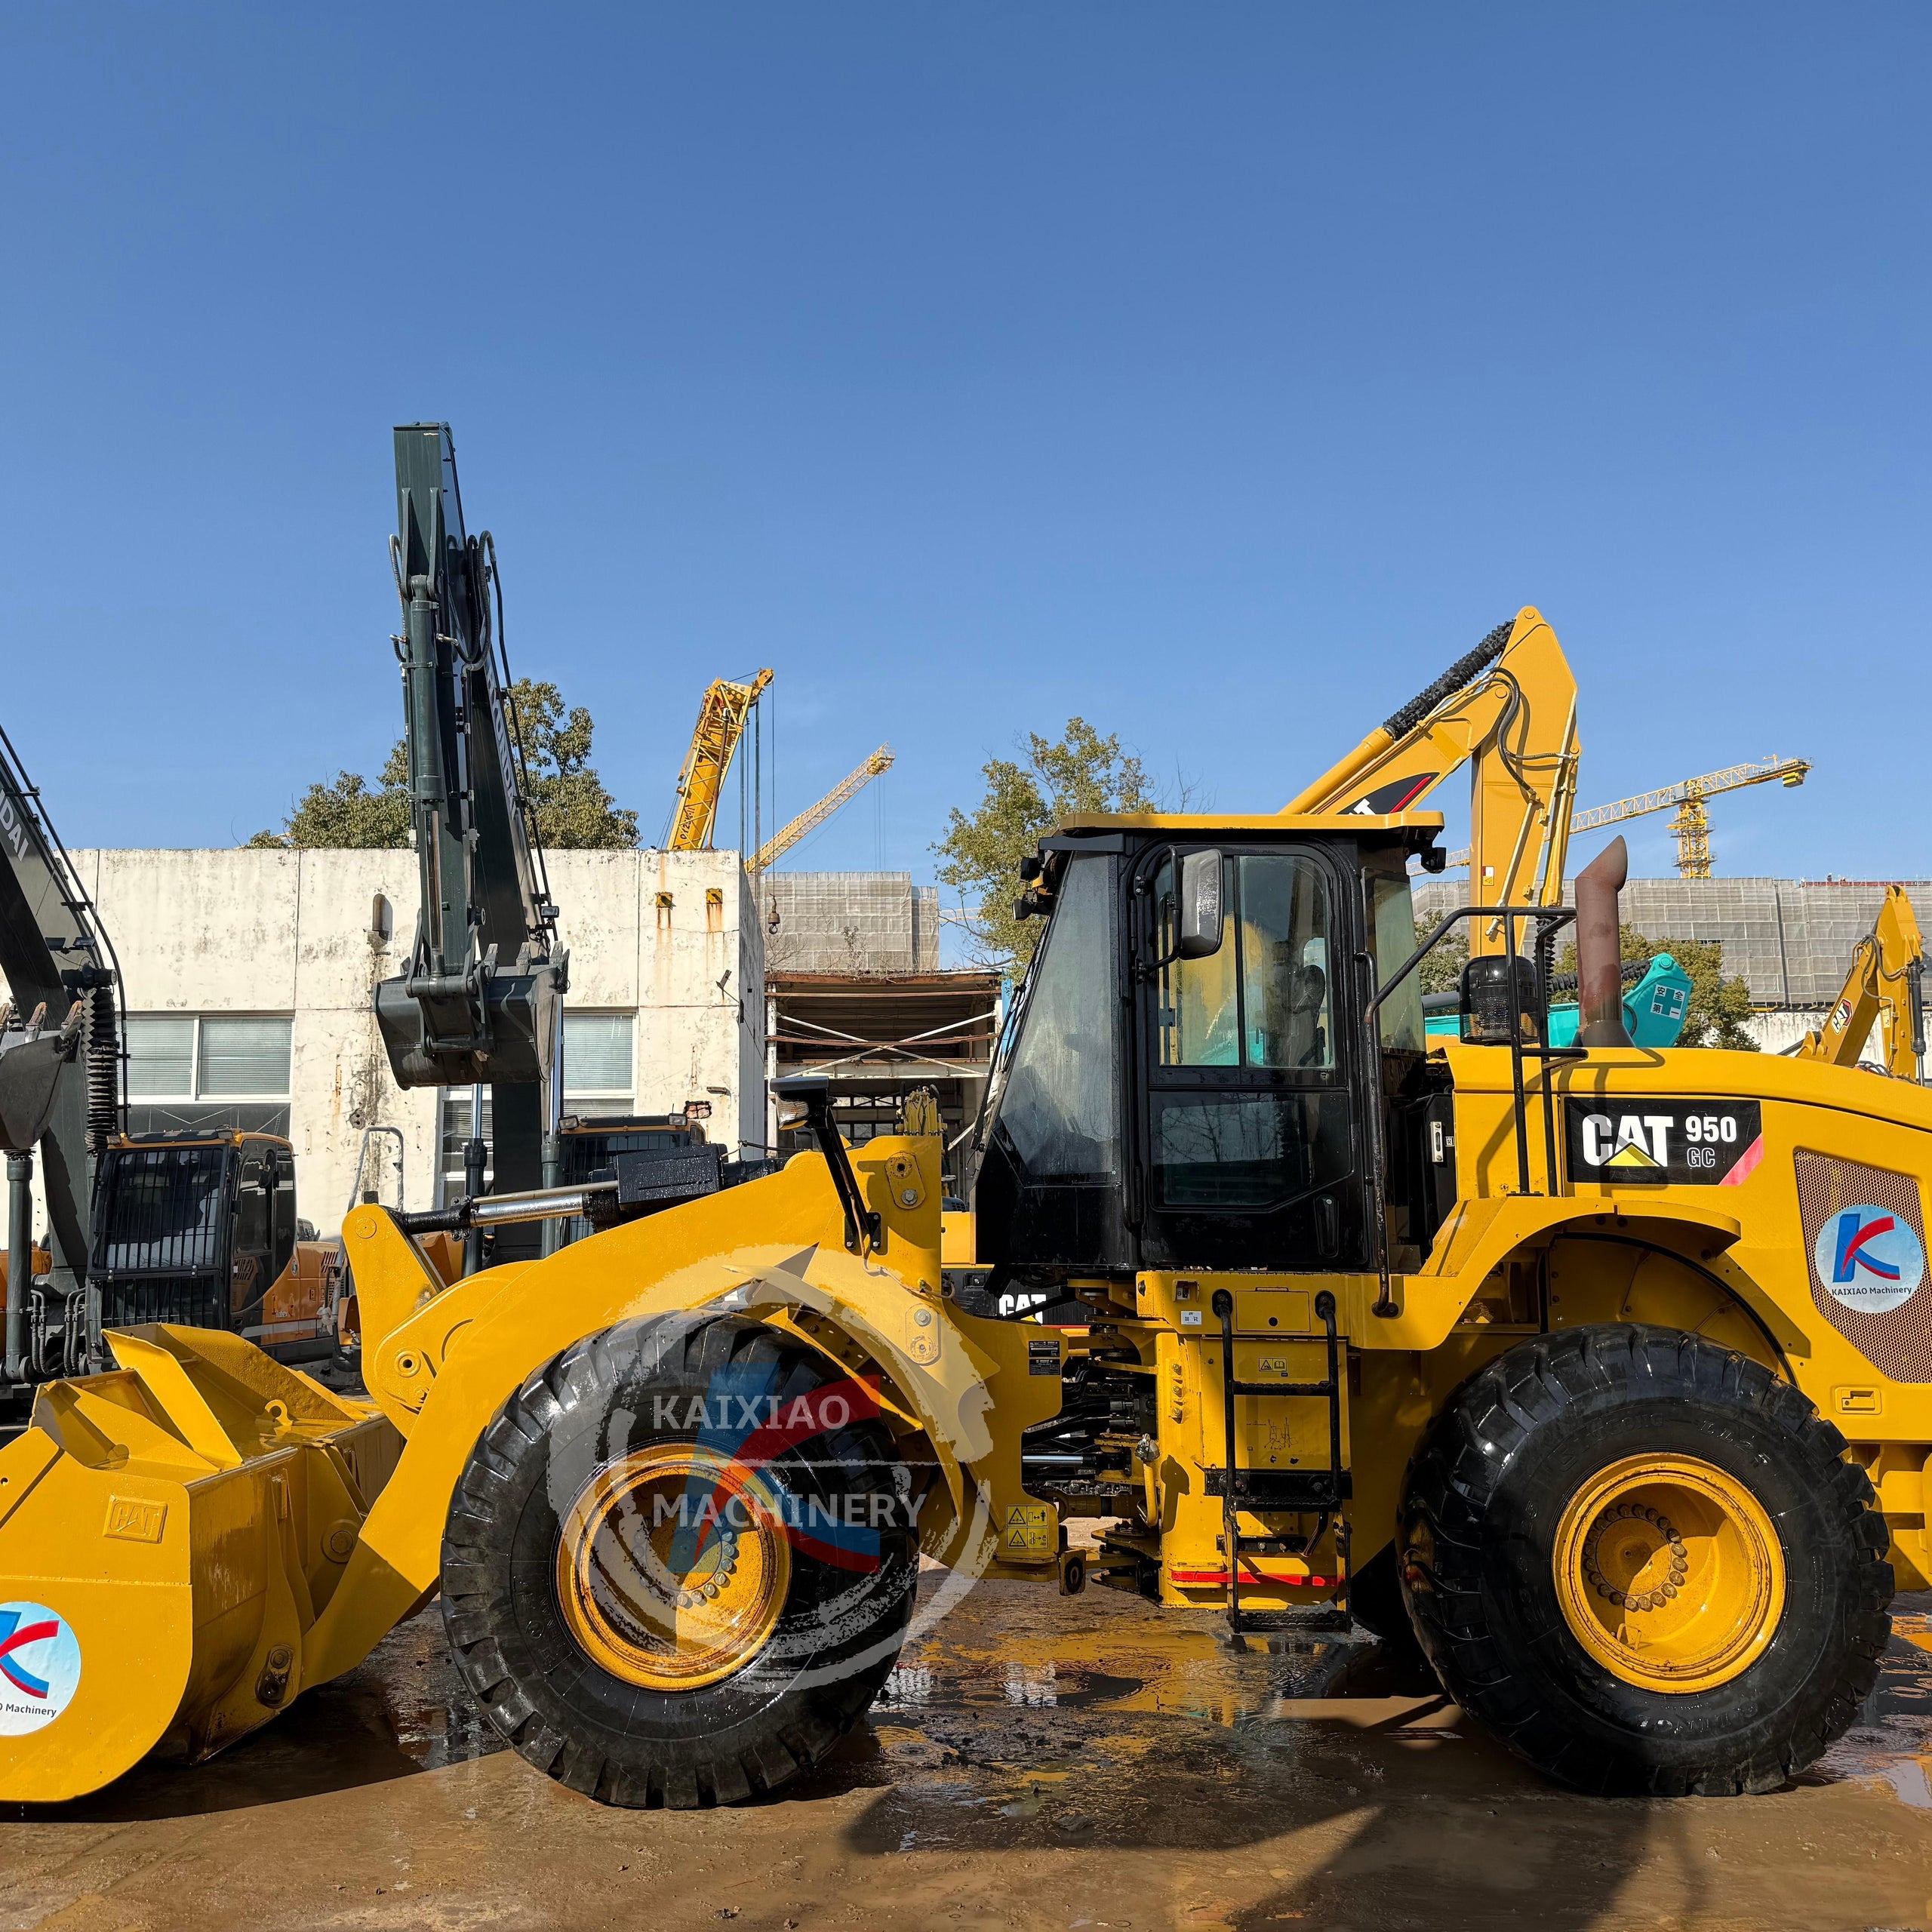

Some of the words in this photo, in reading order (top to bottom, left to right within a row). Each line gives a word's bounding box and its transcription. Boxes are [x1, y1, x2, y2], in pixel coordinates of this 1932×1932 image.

[0, 789, 29, 862] DAI
[1832, 1002, 1849, 1034] CAT
[1582, 1114, 1673, 1167] CAT
[1685, 1115, 1737, 1142] 950
[1687, 1147, 1715, 1168] GC
[1832, 1287, 1868, 1296] KAIXIAO
[1869, 1286, 1912, 1295] Machinery
[6, 1703, 57, 1718] Machinery
